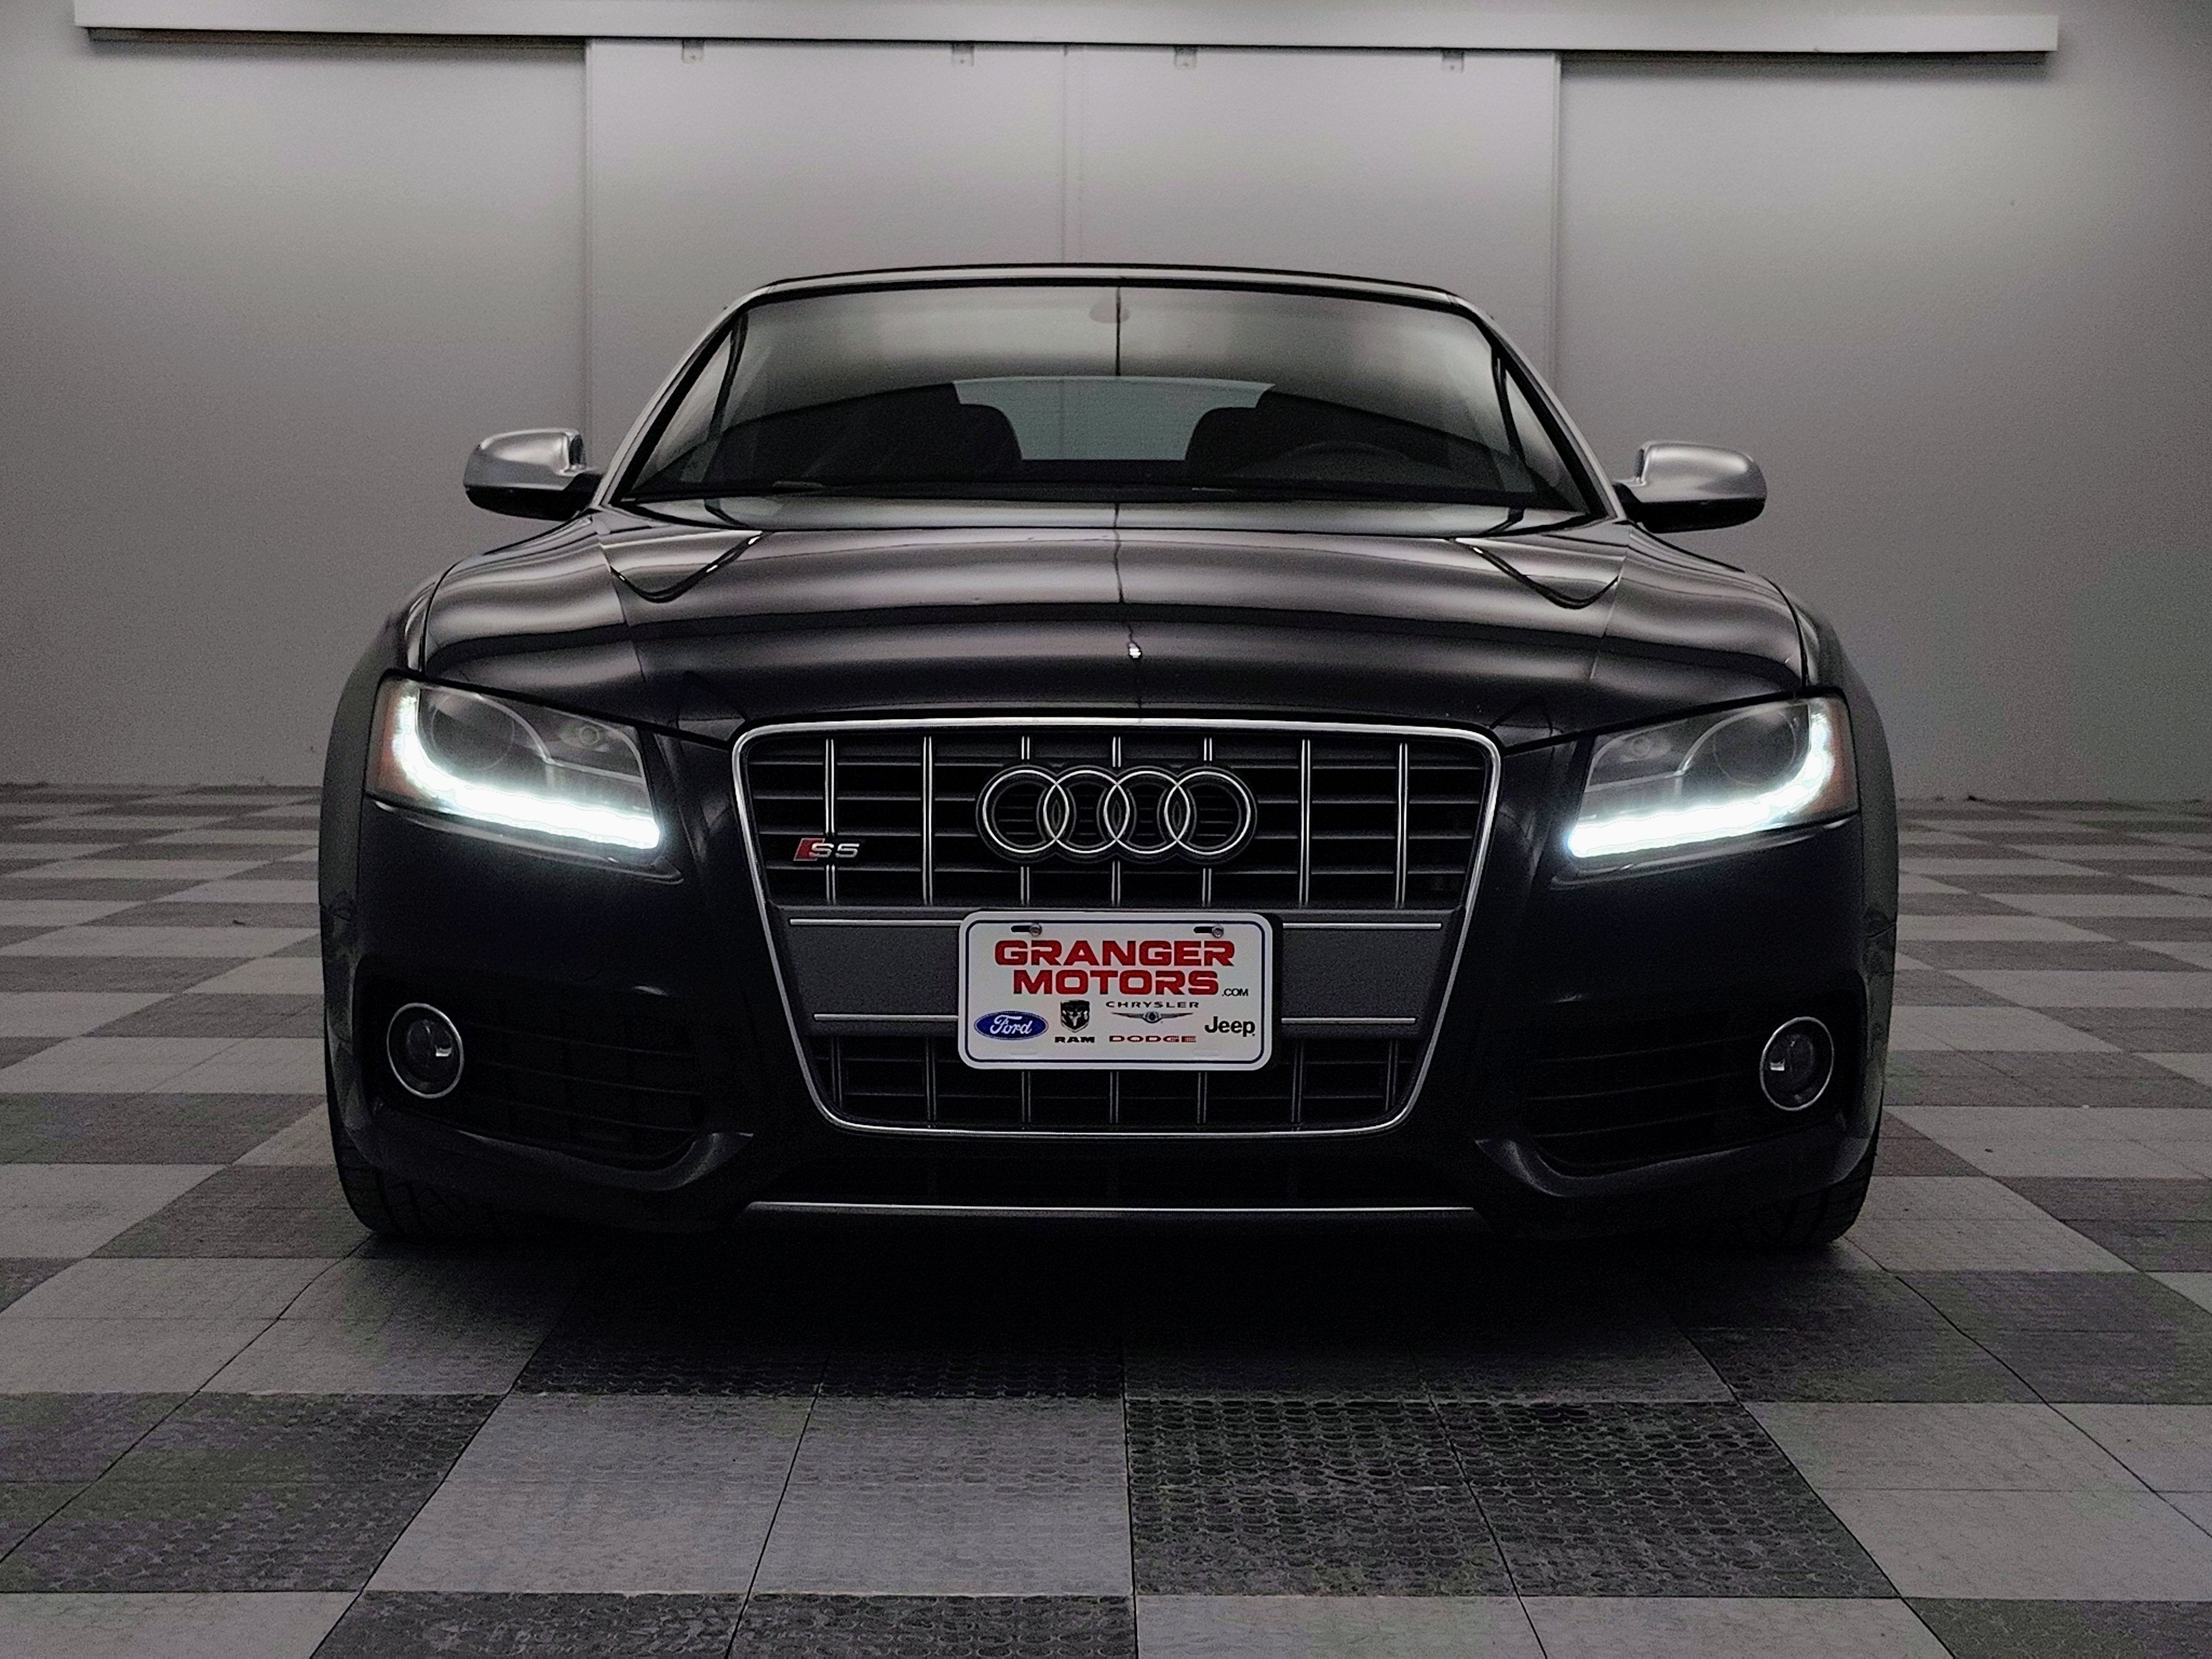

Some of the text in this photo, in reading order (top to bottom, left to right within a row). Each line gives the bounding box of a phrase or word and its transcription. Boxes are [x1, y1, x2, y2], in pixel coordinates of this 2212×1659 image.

[808, 842, 860, 858] S5
[995, 940, 1235, 966] GRANGER
[1013, 969, 1219, 995] MOTORS
[989, 1015, 1033, 1035] Ford
[1205, 1016, 1256, 1037] Jeep
[1109, 1035, 1197, 1043] DODGE
